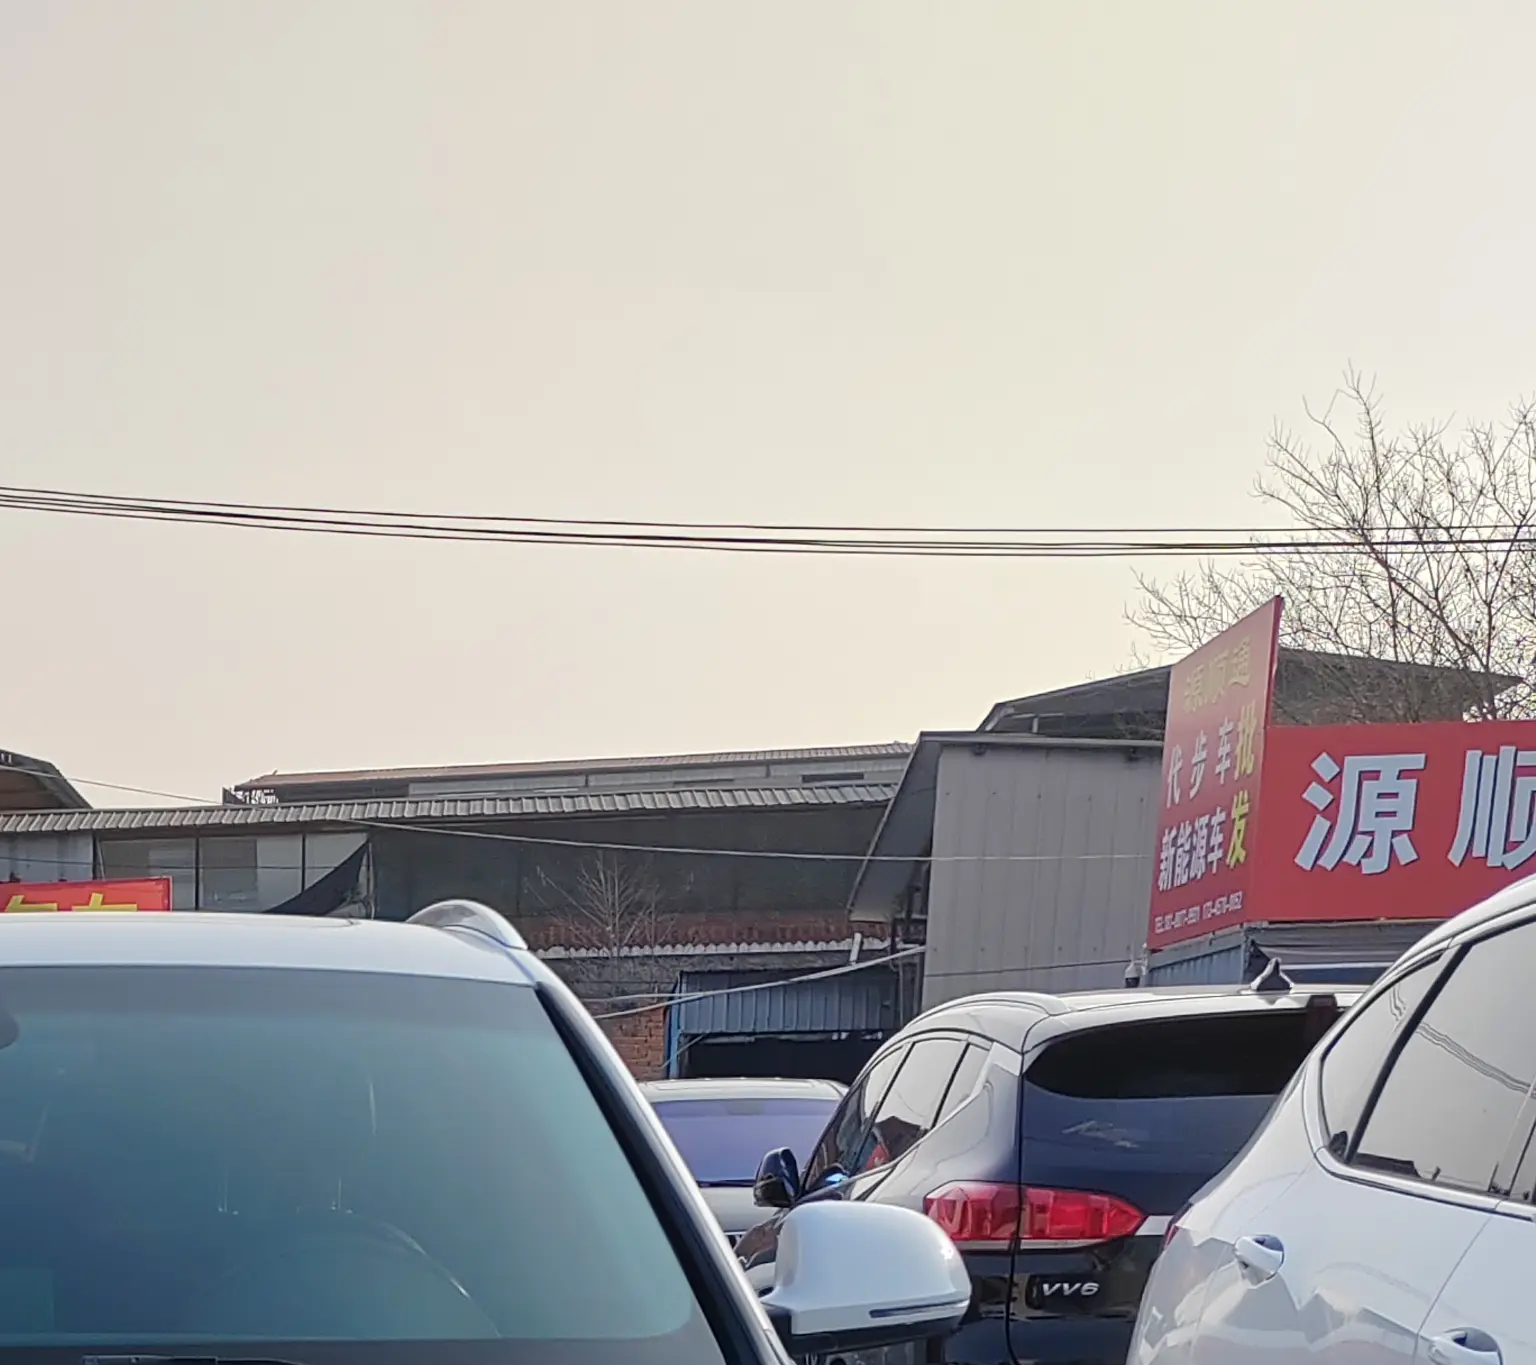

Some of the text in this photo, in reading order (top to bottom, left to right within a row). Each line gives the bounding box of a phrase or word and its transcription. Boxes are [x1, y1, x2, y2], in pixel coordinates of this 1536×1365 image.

[1167, 716, 1234, 809] 代步车
[1158, 806, 1226, 892] 新能源车
[1043, 1282, 1100, 1297] VV6
